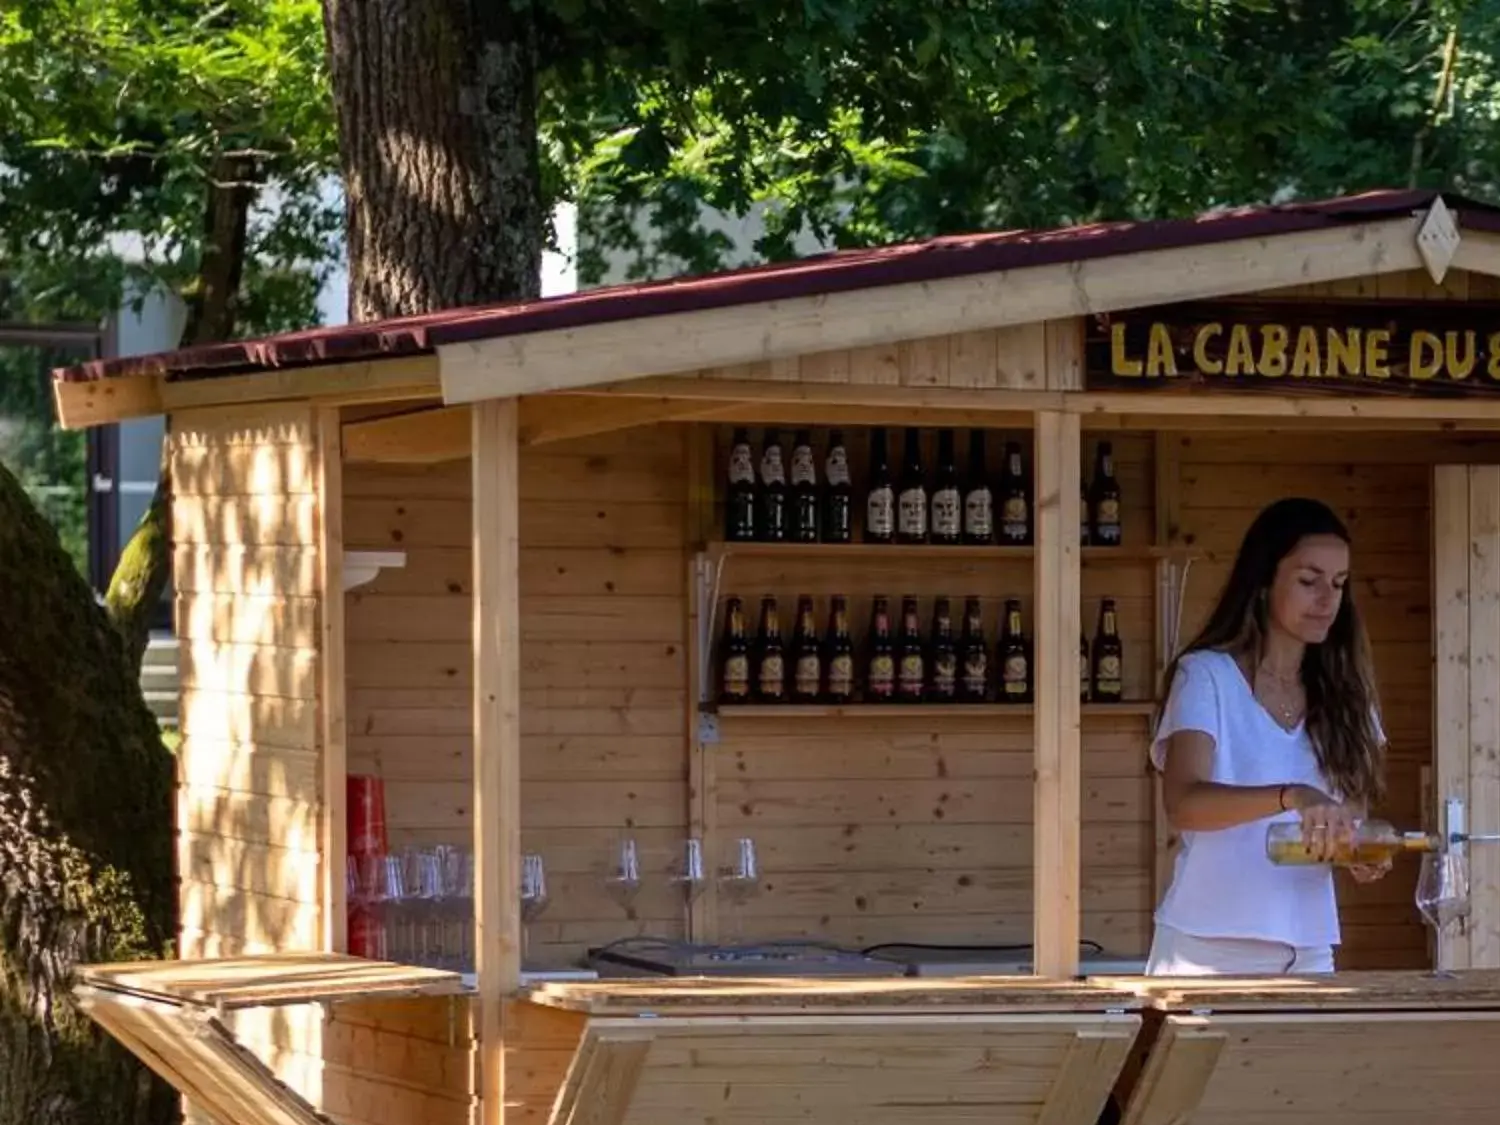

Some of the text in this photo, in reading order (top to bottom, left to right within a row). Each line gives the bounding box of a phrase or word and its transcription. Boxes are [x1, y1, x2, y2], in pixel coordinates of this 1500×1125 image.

[1110, 321, 1177, 377] LA
[1194, 322, 1391, 378] CABANE
[1409, 330, 1477, 380] DU
